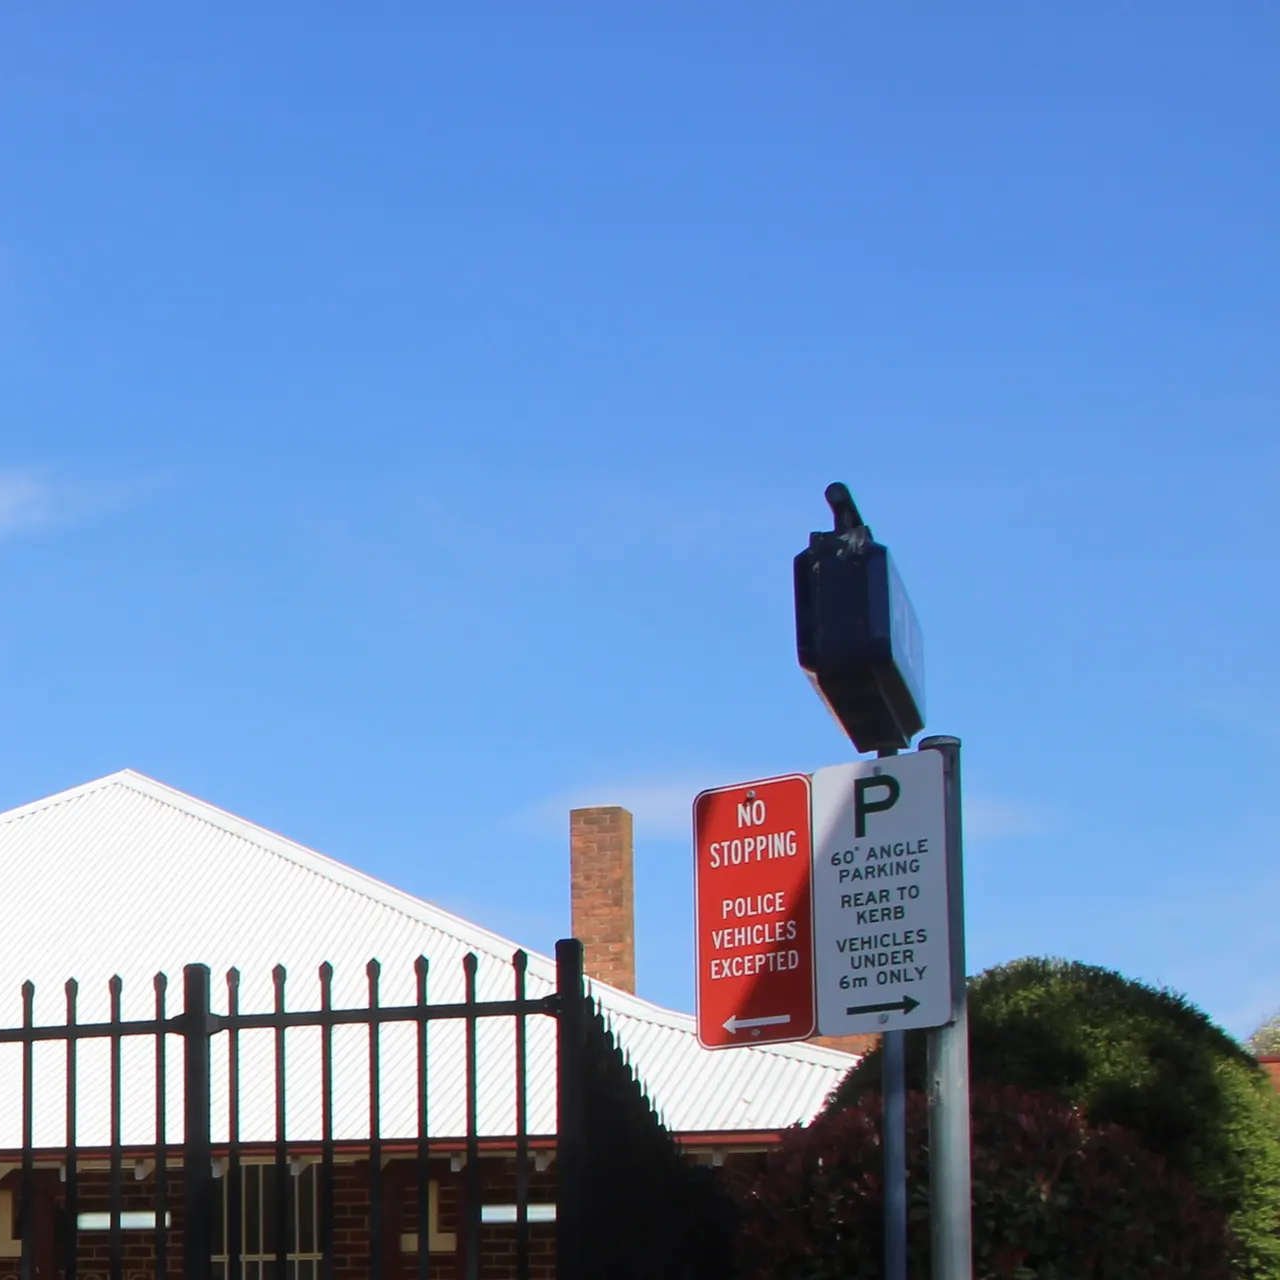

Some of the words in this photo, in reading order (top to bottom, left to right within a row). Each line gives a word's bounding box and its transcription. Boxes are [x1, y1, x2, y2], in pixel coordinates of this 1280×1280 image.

[737, 799, 767, 828] NO
[854, 774, 900, 839] P
[709, 830, 798, 868] STOPPING
[866, 839, 929, 861] ANGLE
[838, 858, 921, 884] PARKING
[721, 891, 786, 920] POLICE
[840, 888, 890, 909] REAR
[896, 885, 920, 901] TO
[856, 905, 905, 925] KERB
[711, 920, 797, 950] VEHICLES
[836, 929, 928, 953] VEHICLES
[710, 950, 800, 980] EXCEPTED
[850, 949, 915, 970] UNDER
[839, 974, 868, 990] 6m
[876, 966, 928, 986] ONLY
